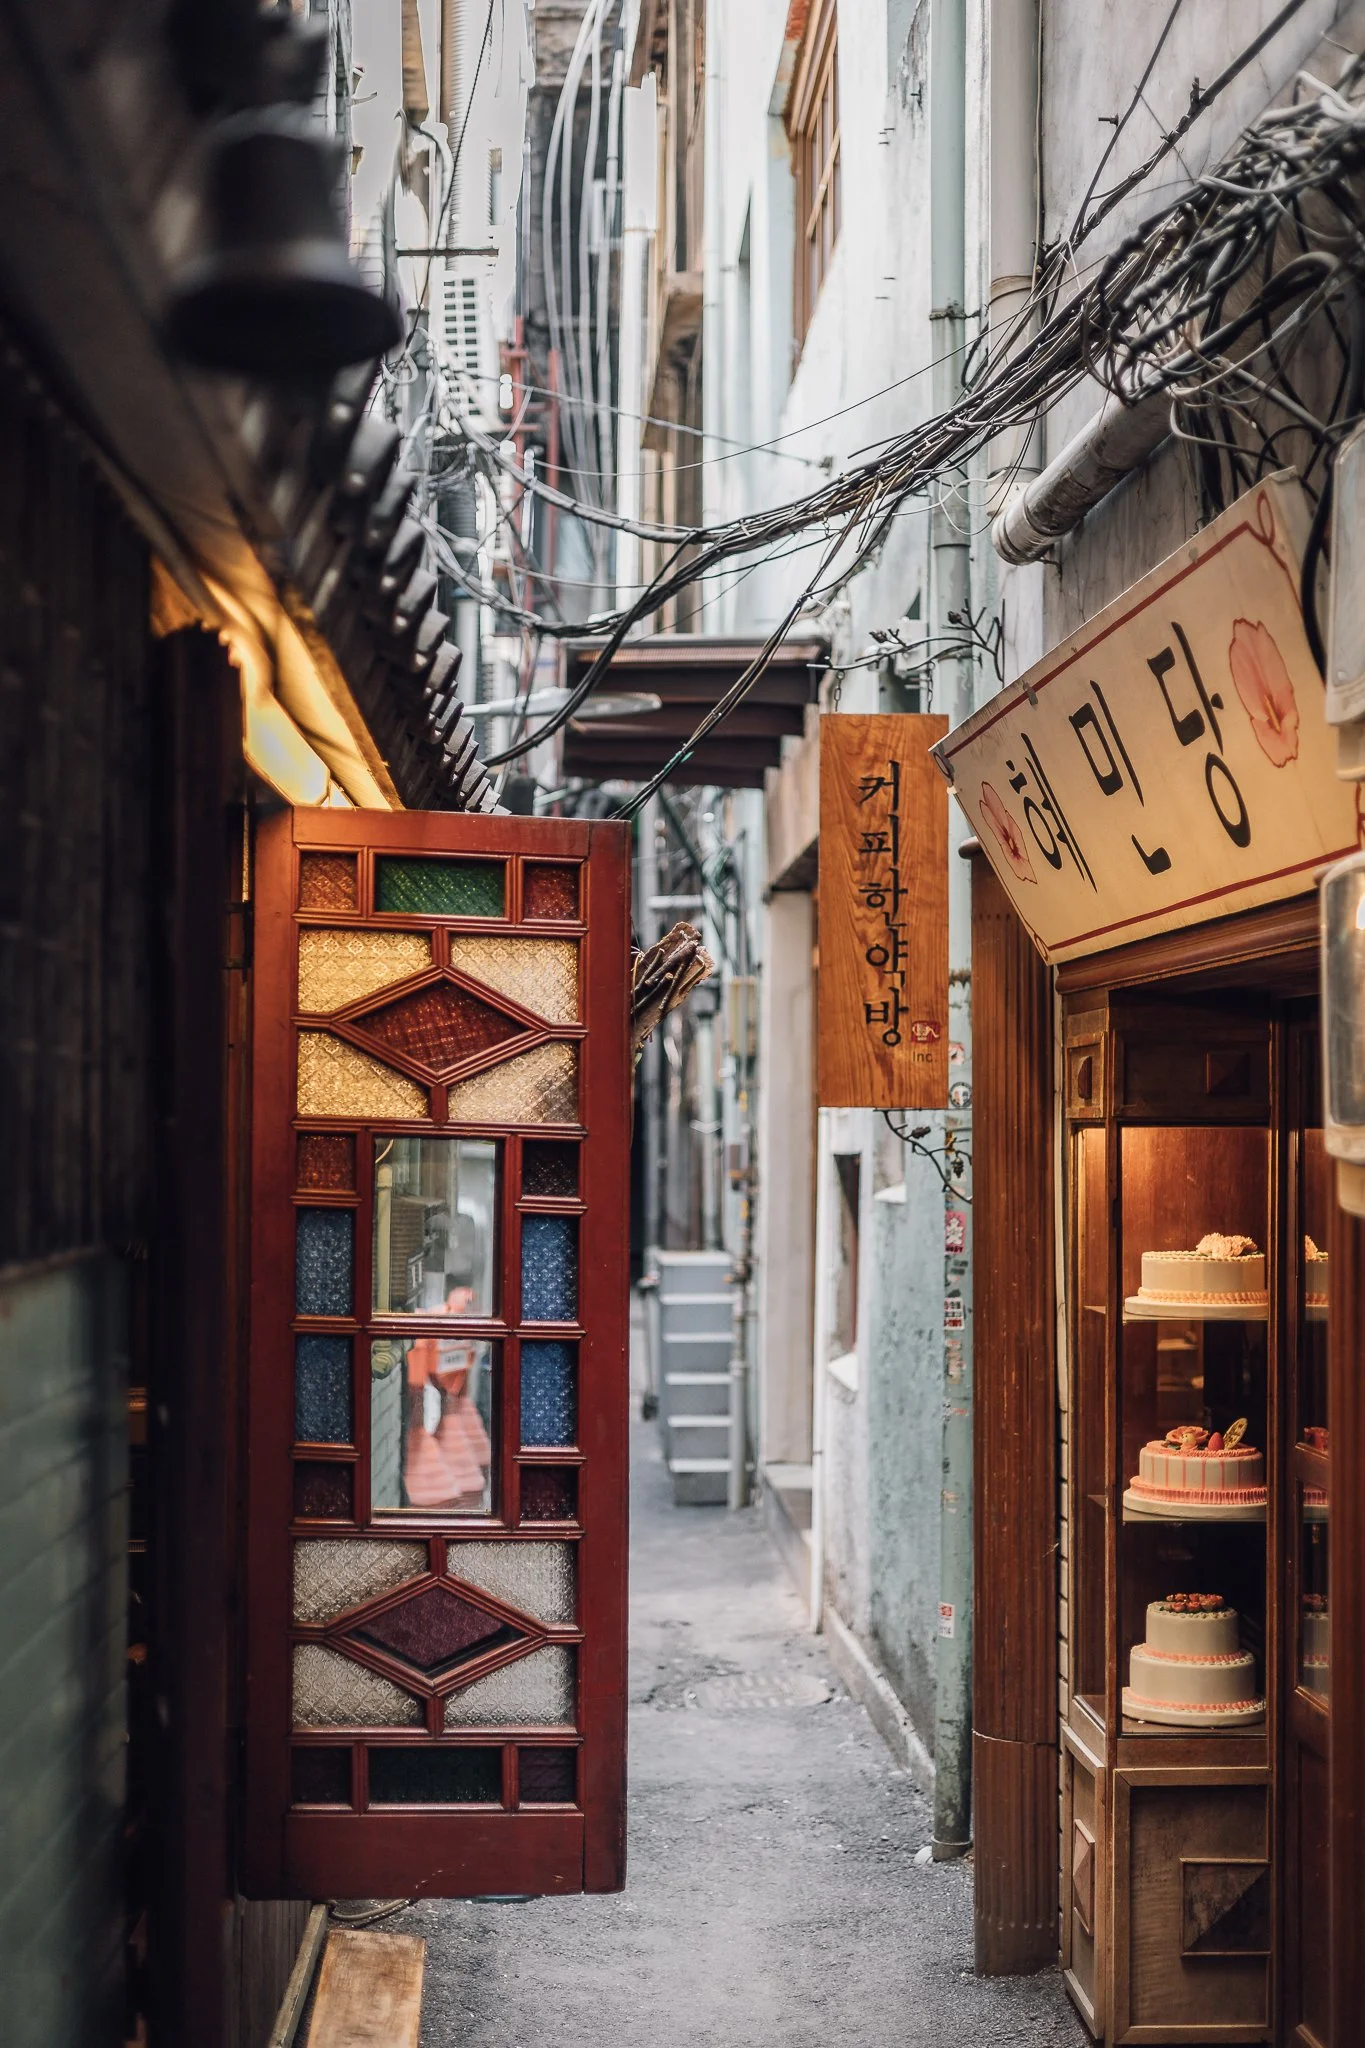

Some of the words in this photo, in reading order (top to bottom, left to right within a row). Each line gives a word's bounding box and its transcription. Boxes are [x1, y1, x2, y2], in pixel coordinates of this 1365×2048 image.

[1005, 621, 1251, 894] 혜민당
[858, 760, 909, 1047] 커피한약방
[912, 1051, 938, 1063] Inc.
